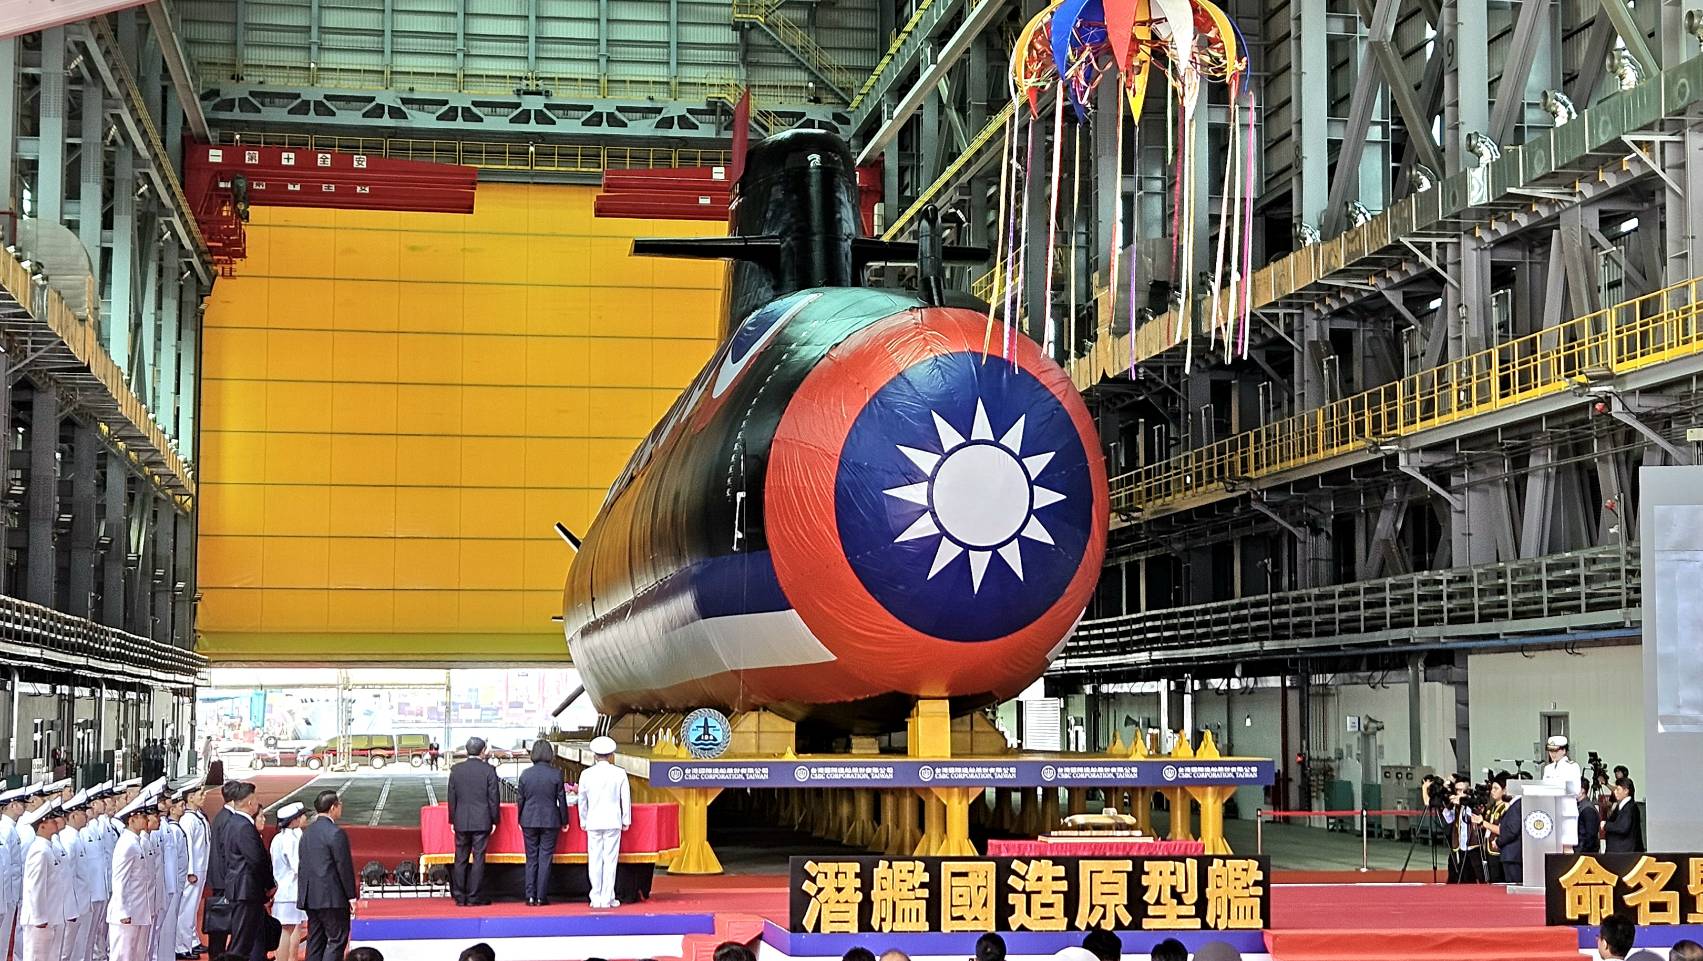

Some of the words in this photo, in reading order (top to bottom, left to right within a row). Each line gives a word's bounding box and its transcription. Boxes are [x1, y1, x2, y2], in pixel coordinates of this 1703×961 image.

[801, 858, 1264, 932] 潛艦國造原型艦
